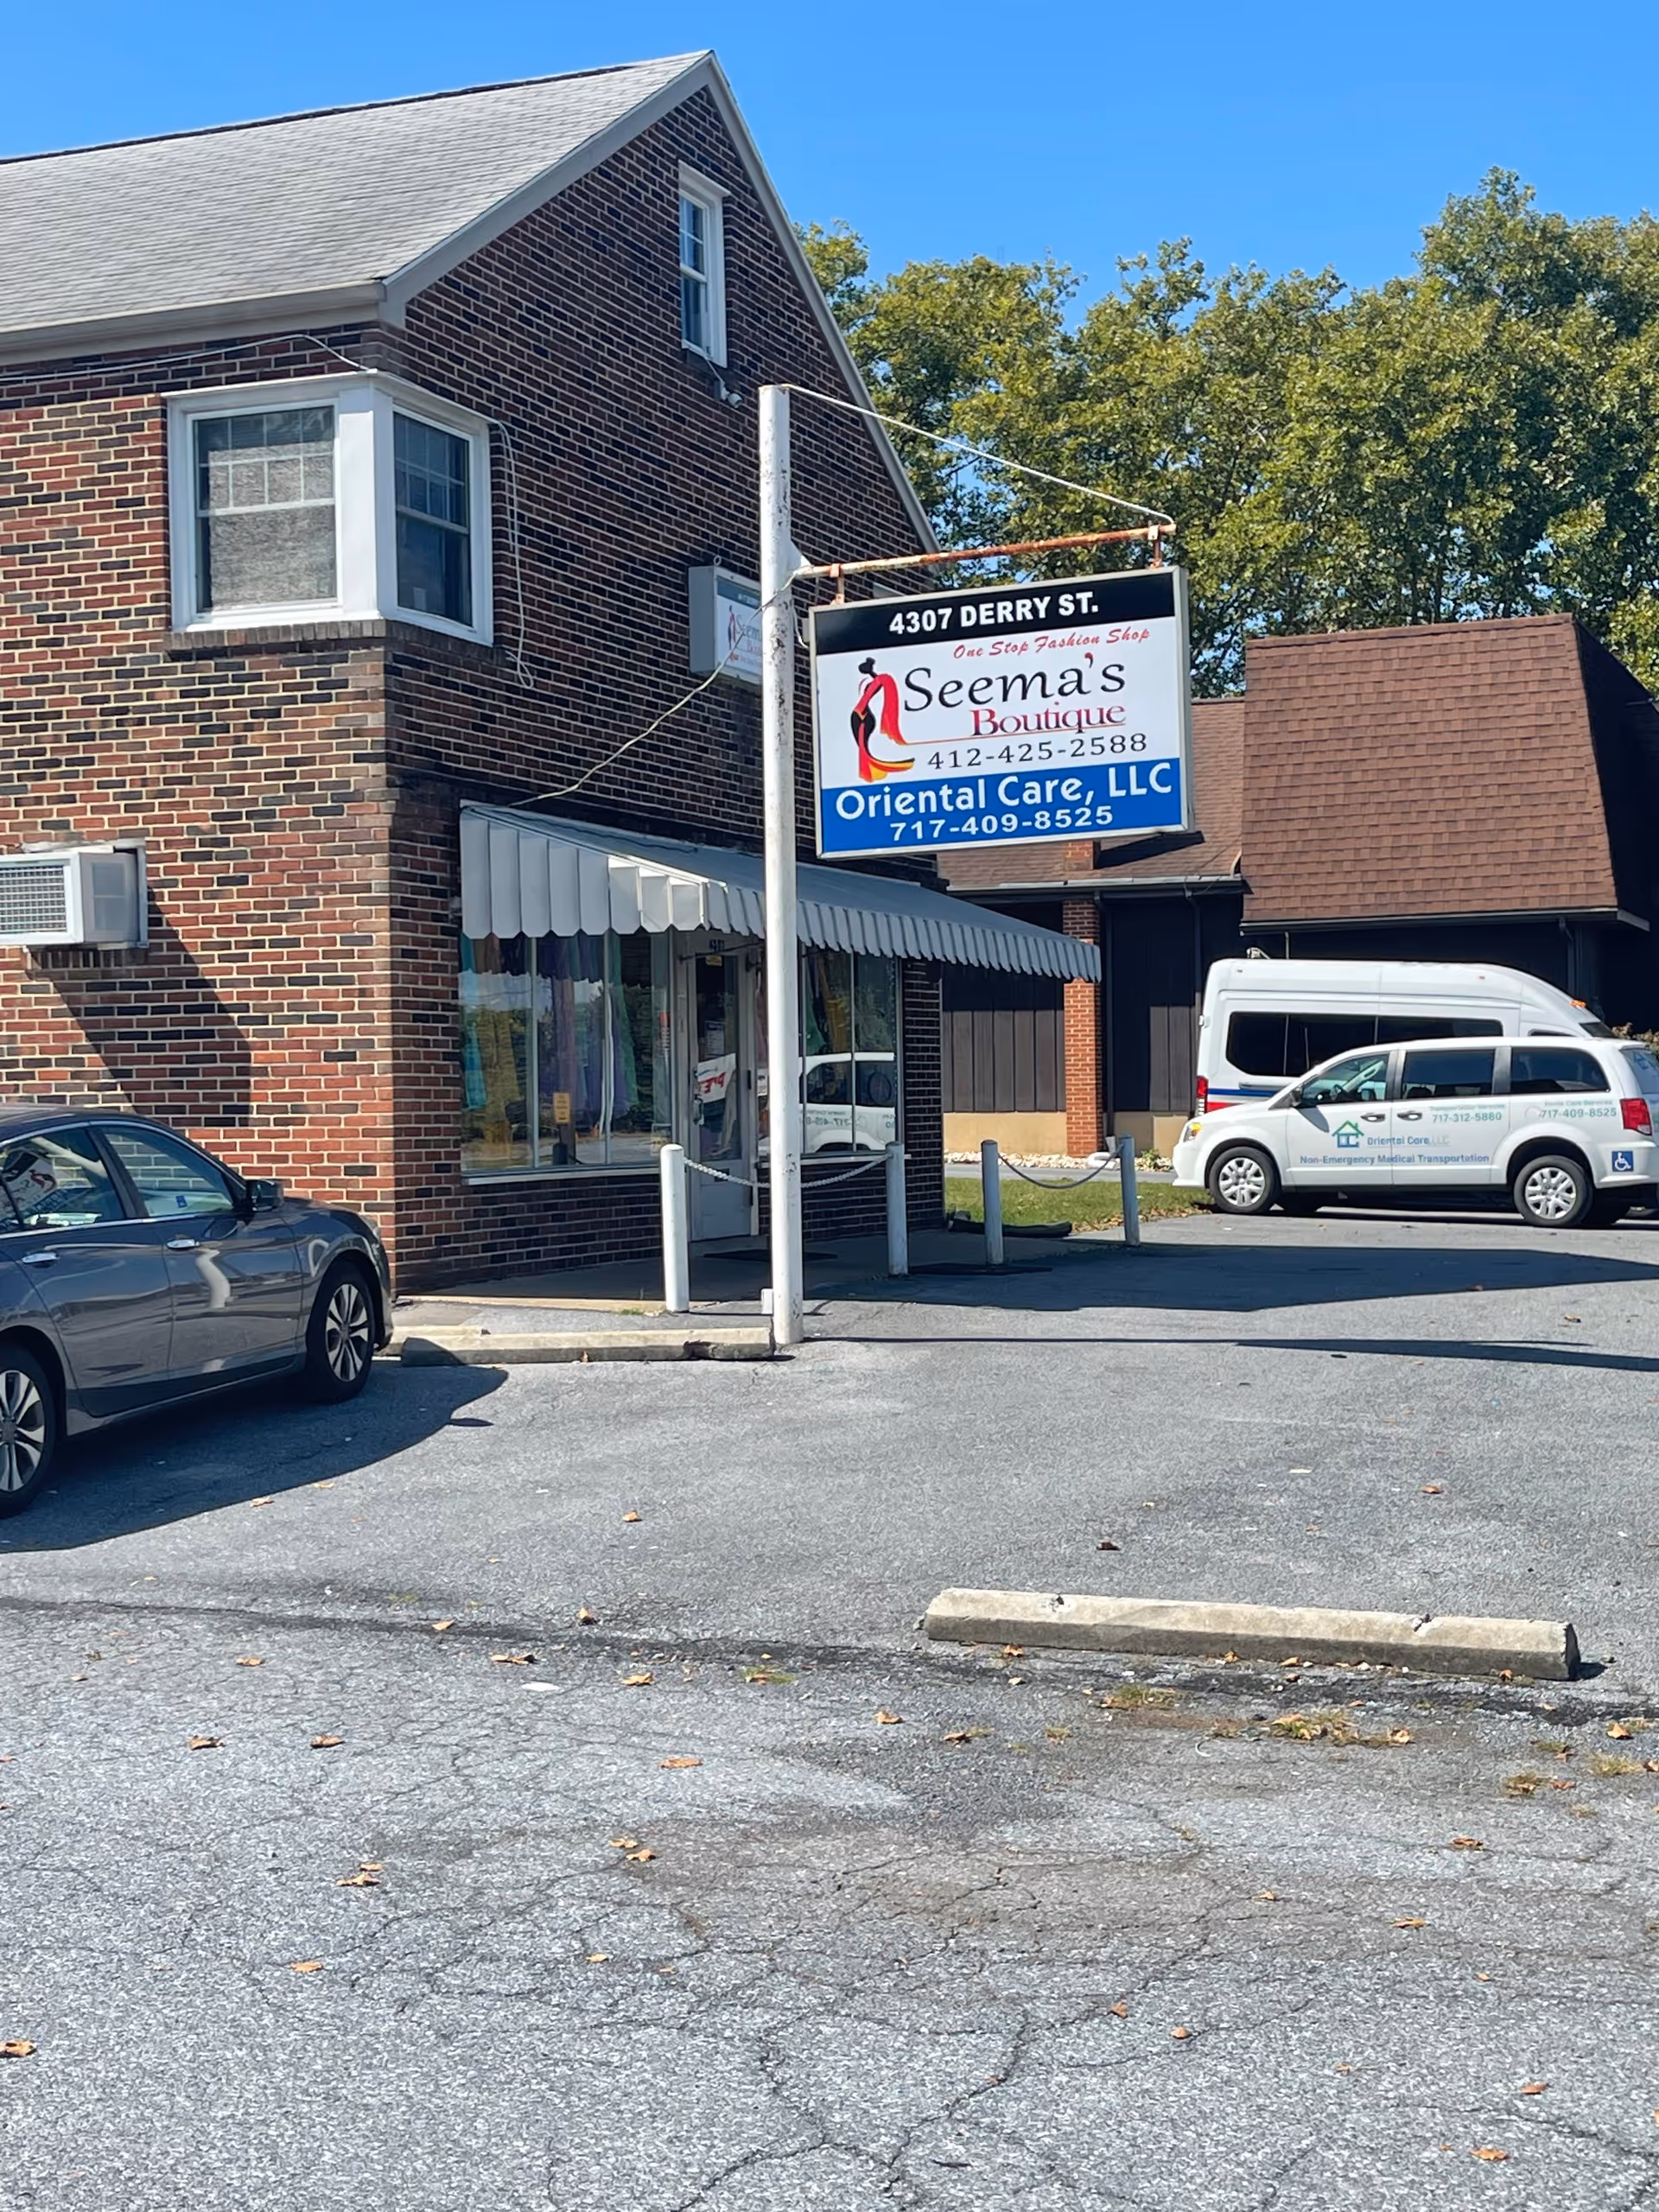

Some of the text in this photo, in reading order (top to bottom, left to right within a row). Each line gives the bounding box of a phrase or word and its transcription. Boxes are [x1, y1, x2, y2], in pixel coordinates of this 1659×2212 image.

[890, 592, 1098, 634] 4307 DERRY ST.
[953, 626, 1151, 660] One Stop Fashion Shop
[904, 652, 1126, 712] Seema's
[969, 701, 1127, 737] Boutique
[927, 733, 1147, 770] 412-425-2588
[836, 762, 1173, 820] Oriental Care, LLC
[890, 805, 1113, 842] 717-409-8525
[1432, 1111, 1503, 1123] 717-312-5880
[1541, 1107, 1618, 1119] 717-409-8525
[1367, 1135, 1405, 1146] Oriental
[1300, 1154, 1490, 1166] Non-Emergency Medical Transportation
